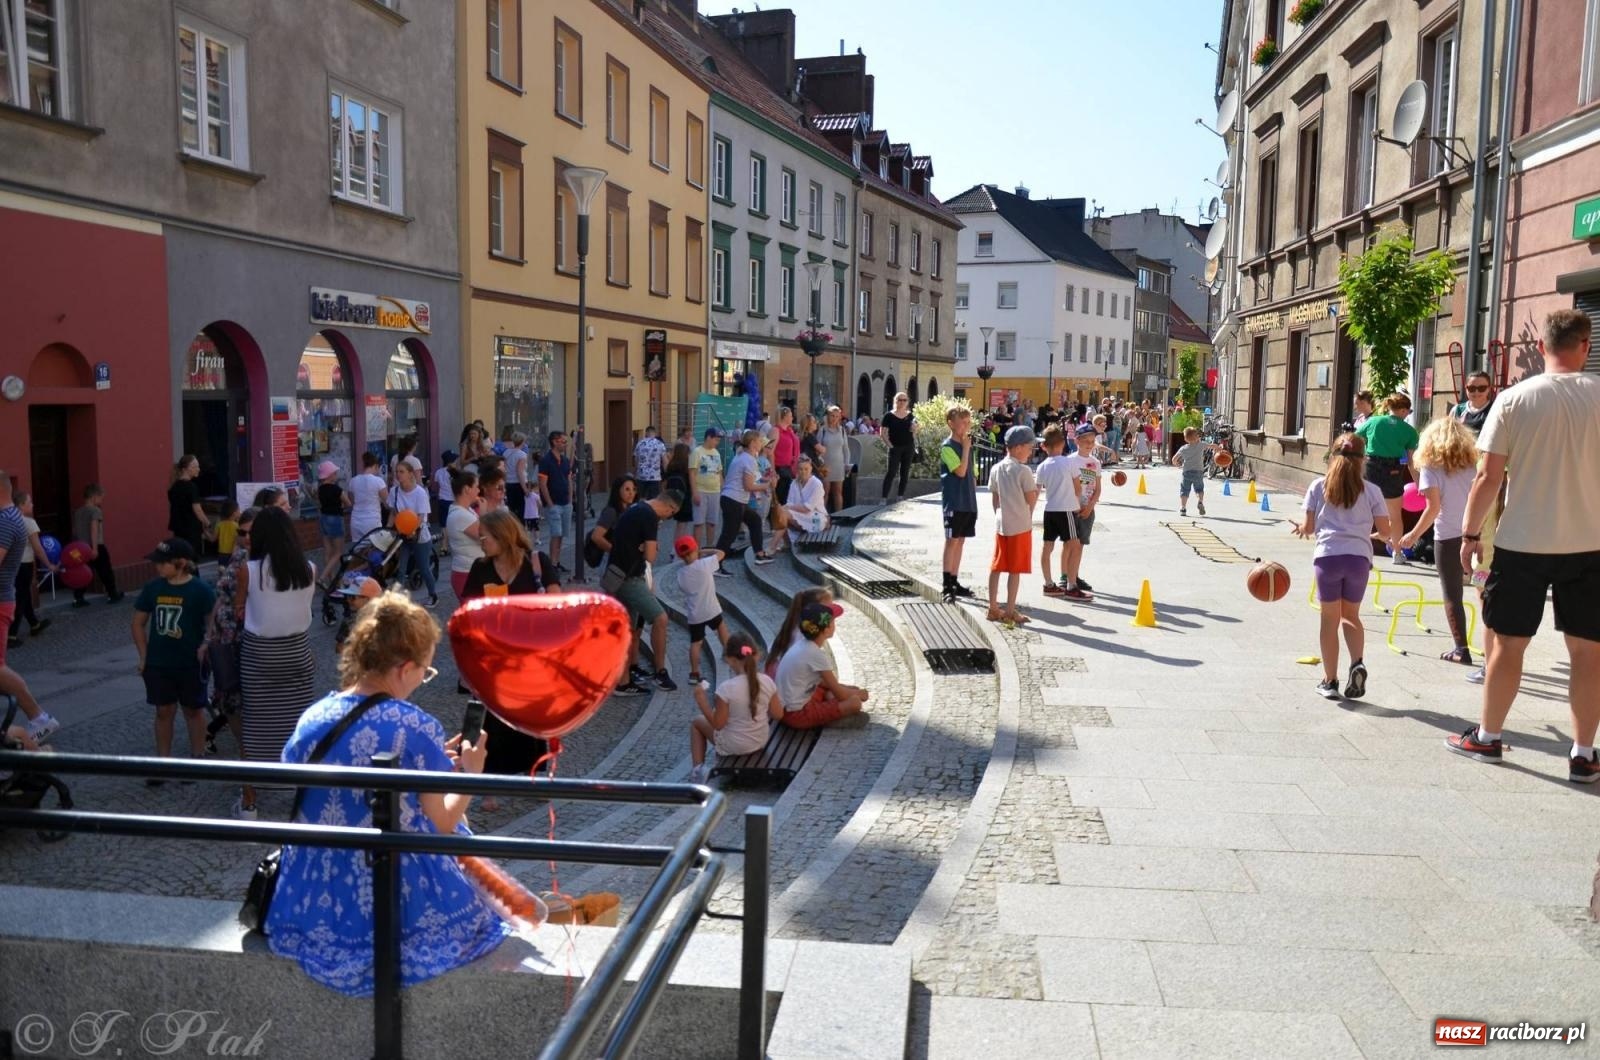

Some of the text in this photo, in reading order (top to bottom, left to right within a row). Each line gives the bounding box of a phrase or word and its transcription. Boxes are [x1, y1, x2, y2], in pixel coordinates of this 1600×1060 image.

[377, 307, 410, 329] home
[99, 366, 108, 378] 16
[155, 604, 183, 636] 07
